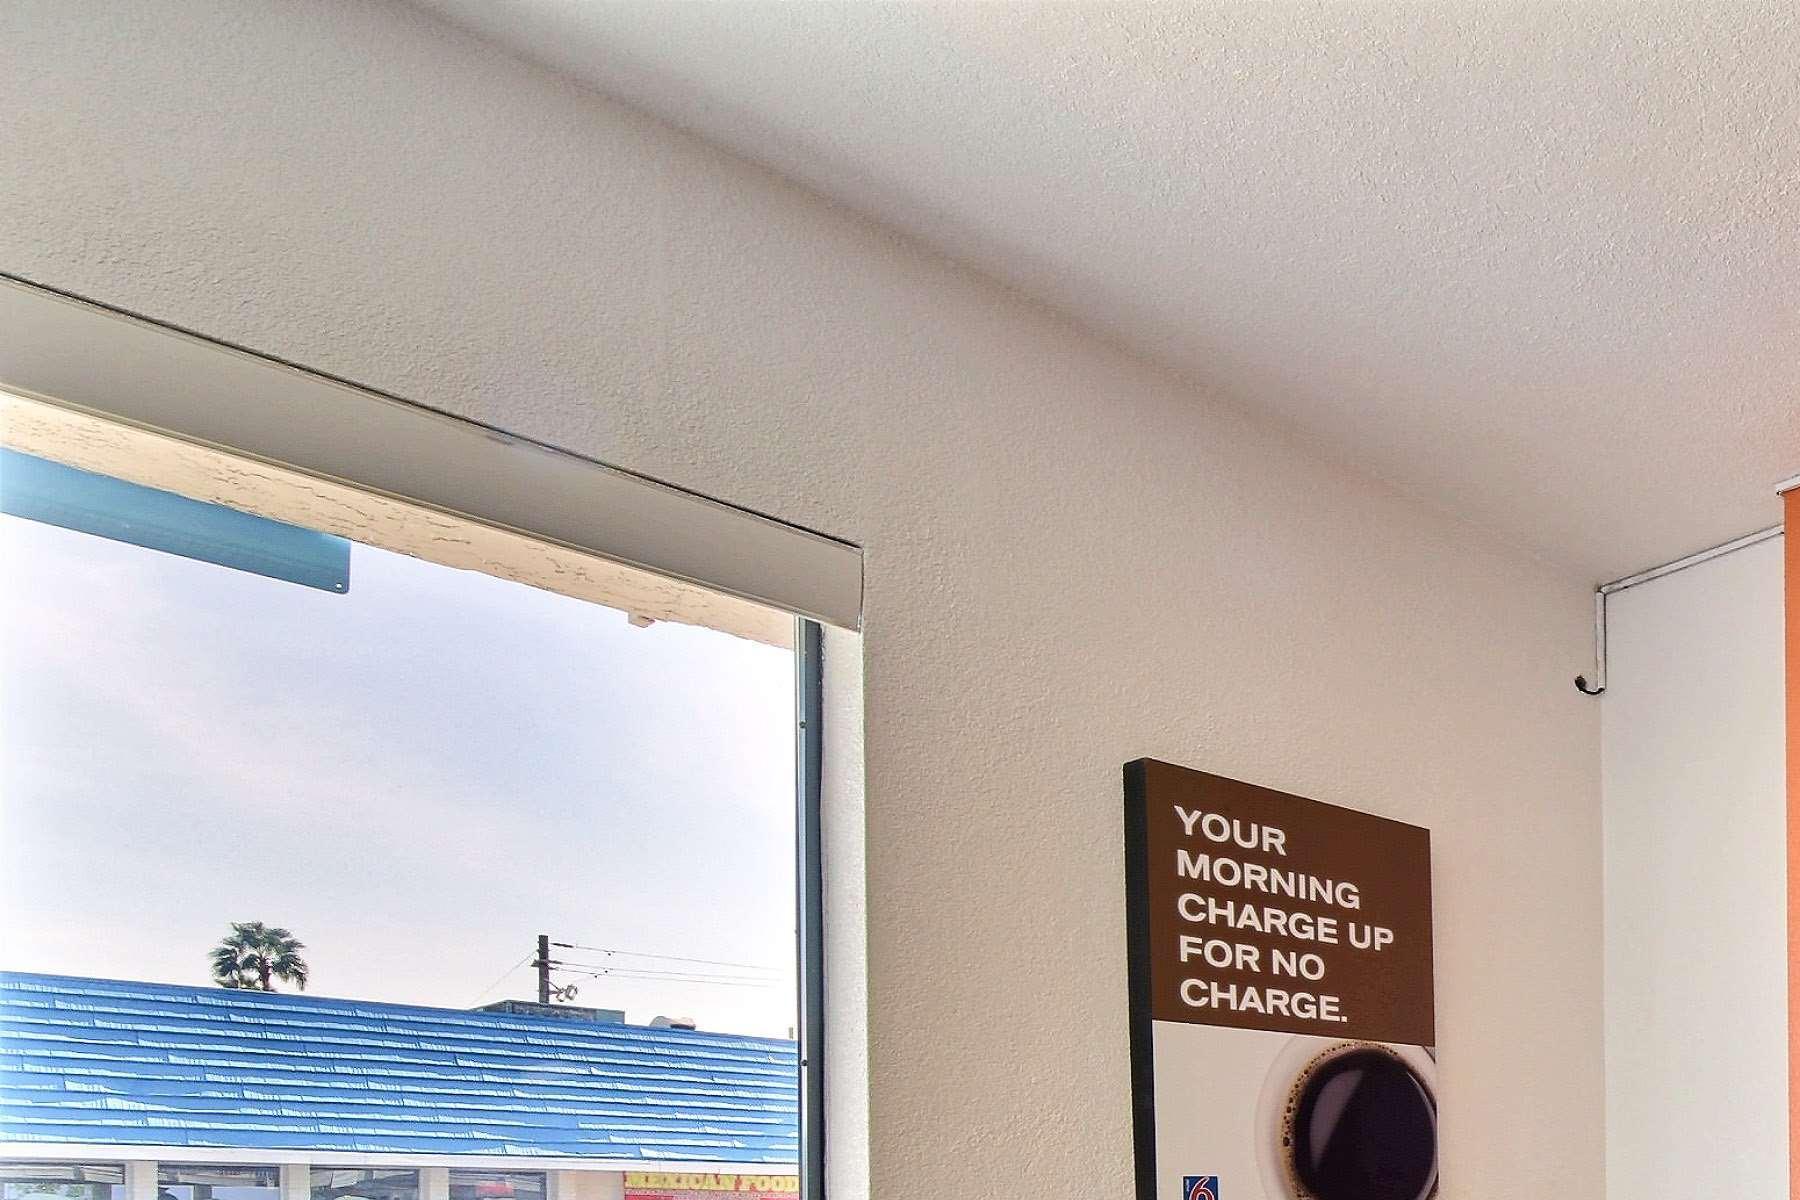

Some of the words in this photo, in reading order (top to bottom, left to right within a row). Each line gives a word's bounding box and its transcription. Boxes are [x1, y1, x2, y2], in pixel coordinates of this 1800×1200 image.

[1174, 805, 1287, 856] YOUR
[1176, 849, 1361, 910] MORNING
[1177, 893, 1339, 945] CHARGE
[1349, 922, 1395, 951] UP
[1179, 935, 1262, 973] FOR
[1272, 949, 1326, 981] NO
[1180, 978, 1348, 1023] CHARGE.
